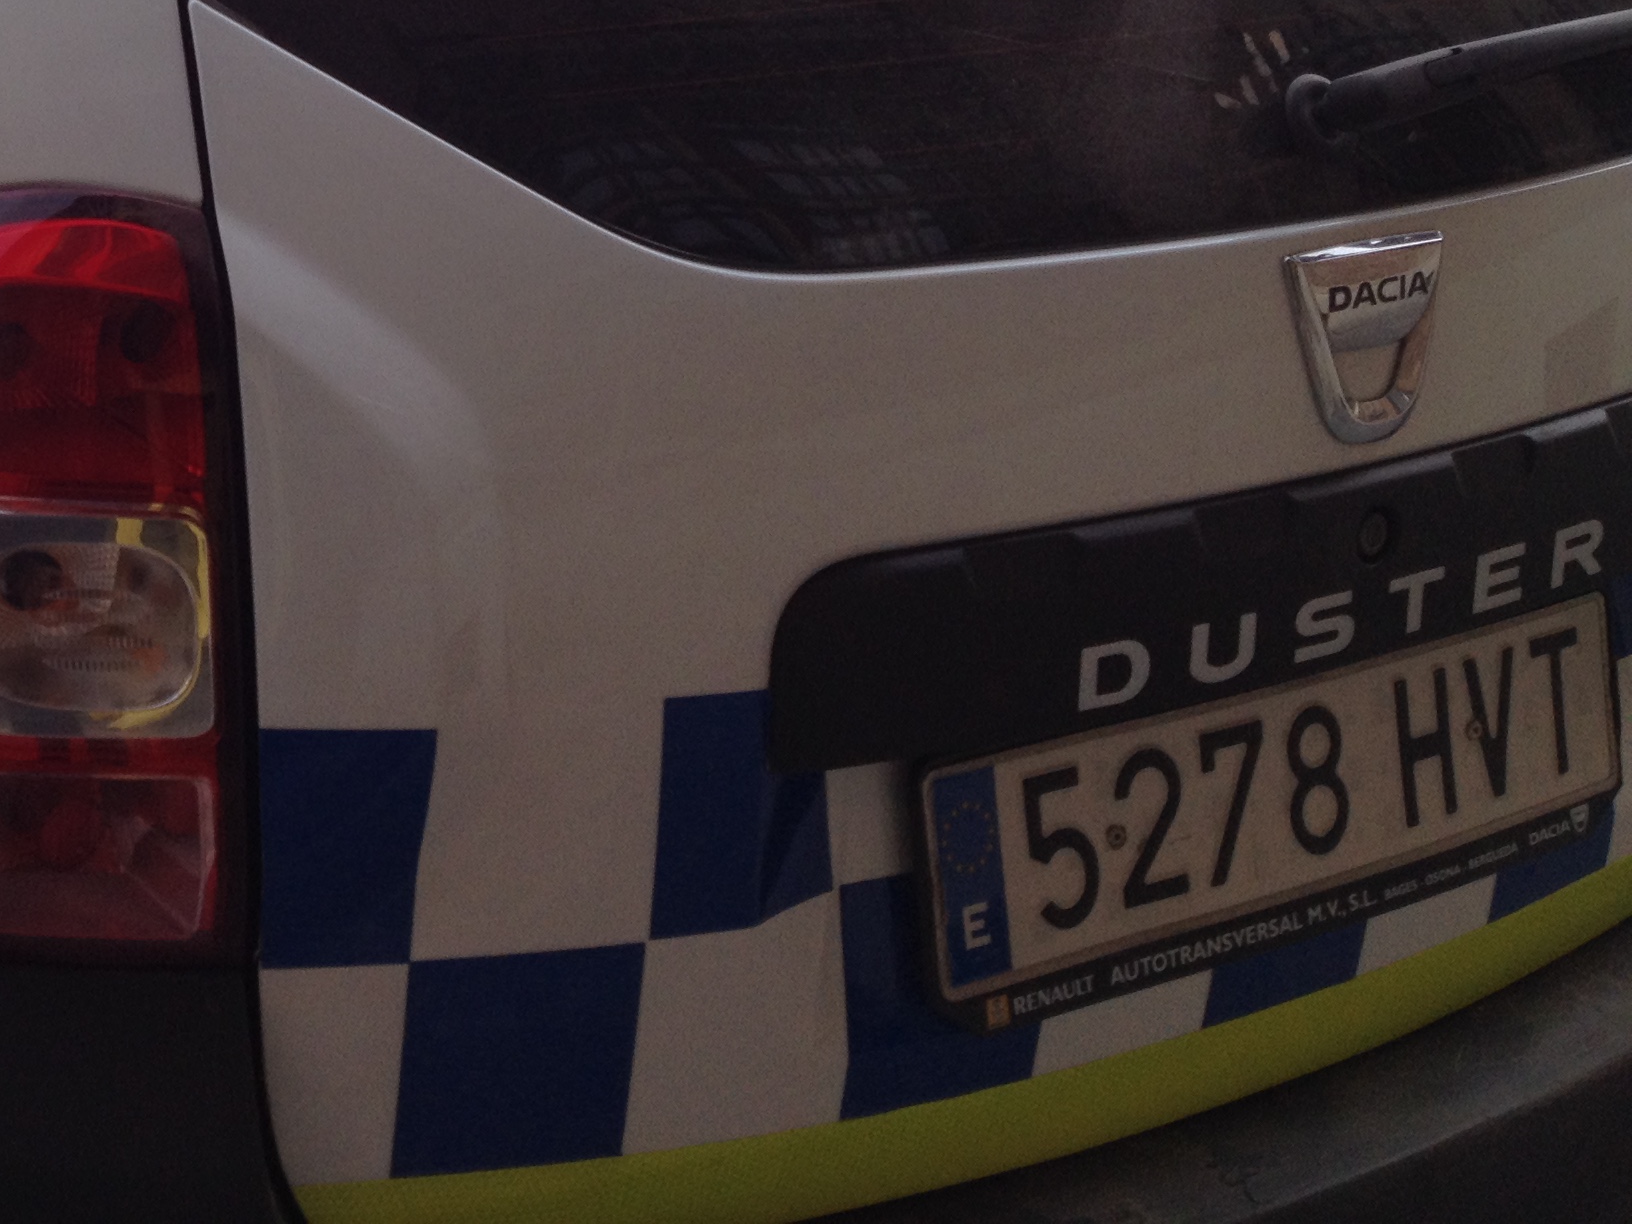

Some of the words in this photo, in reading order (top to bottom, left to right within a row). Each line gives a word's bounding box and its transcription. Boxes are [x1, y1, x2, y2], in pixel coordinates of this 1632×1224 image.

[1328, 271, 1429, 313] DACIA
[1077, 519, 1605, 712] DUSTER
[1020, 705, 1351, 930] 5278
[1392, 627, 1579, 828] HVT
[962, 902, 991, 951] E
[1013, 976, 1093, 1016] RENAULT
[1110, 913, 1304, 987] AUTOTRANSVERSAL
[1384, 881, 1418, 901] BAGES
[1528, 819, 1571, 846] DACIA
